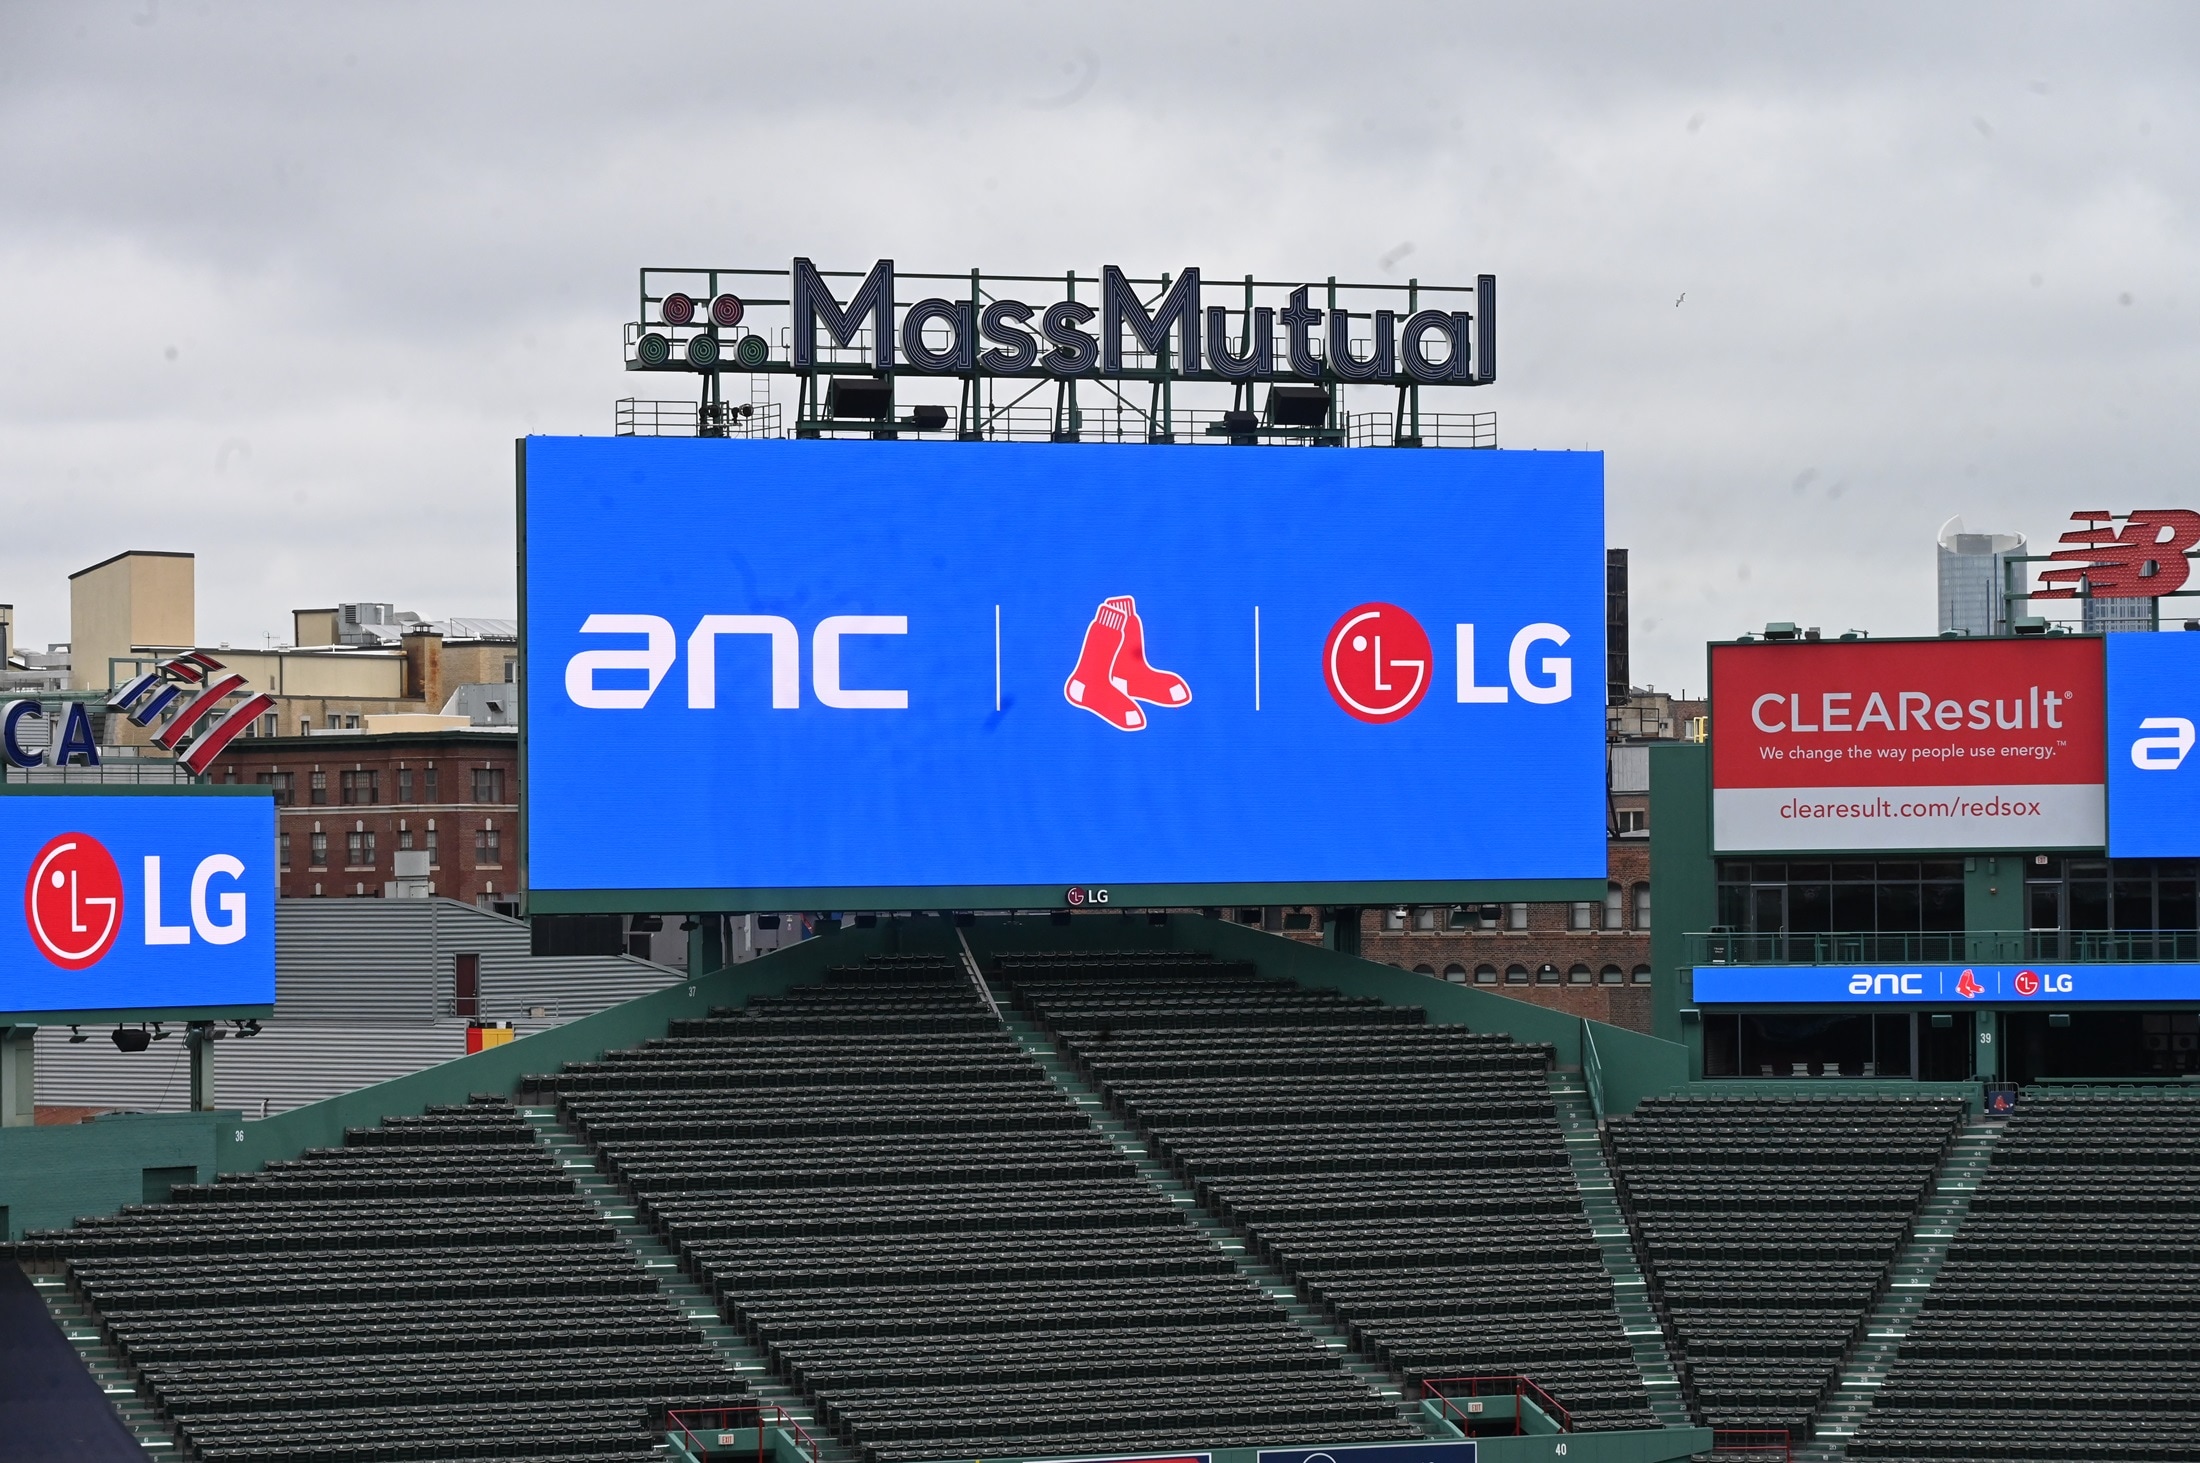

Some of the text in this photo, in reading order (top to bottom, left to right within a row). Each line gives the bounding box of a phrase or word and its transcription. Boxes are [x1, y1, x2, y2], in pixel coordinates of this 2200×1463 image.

[789, 256, 1495, 384] MassMutual
[565, 614, 908, 709] anc
[1455, 622, 1572, 704] LG
[1759, 746, 1784, 761] We
[1788, 744, 1843, 762] change
[1847, 744, 1873, 759] the
[1876, 747, 1907, 762] way
[1911, 743, 1965, 762] people
[1969, 747, 1996, 758] use
[2131, 717, 2196, 770] a
[1780, 796, 2042, 819] clearesult.com/redsox
[144, 853, 246, 946] LG
[1088, 889, 1109, 903] LG
[688, 985, 697, 997] 37
[1848, 974, 1923, 995] anc
[2044, 974, 2073, 993] LG
[1980, 1033, 1992, 1044] 39
[235, 1130, 244, 1141] 36
[721, 1436, 732, 1444] EXIT
[1555, 1443, 1567, 1456] 40
